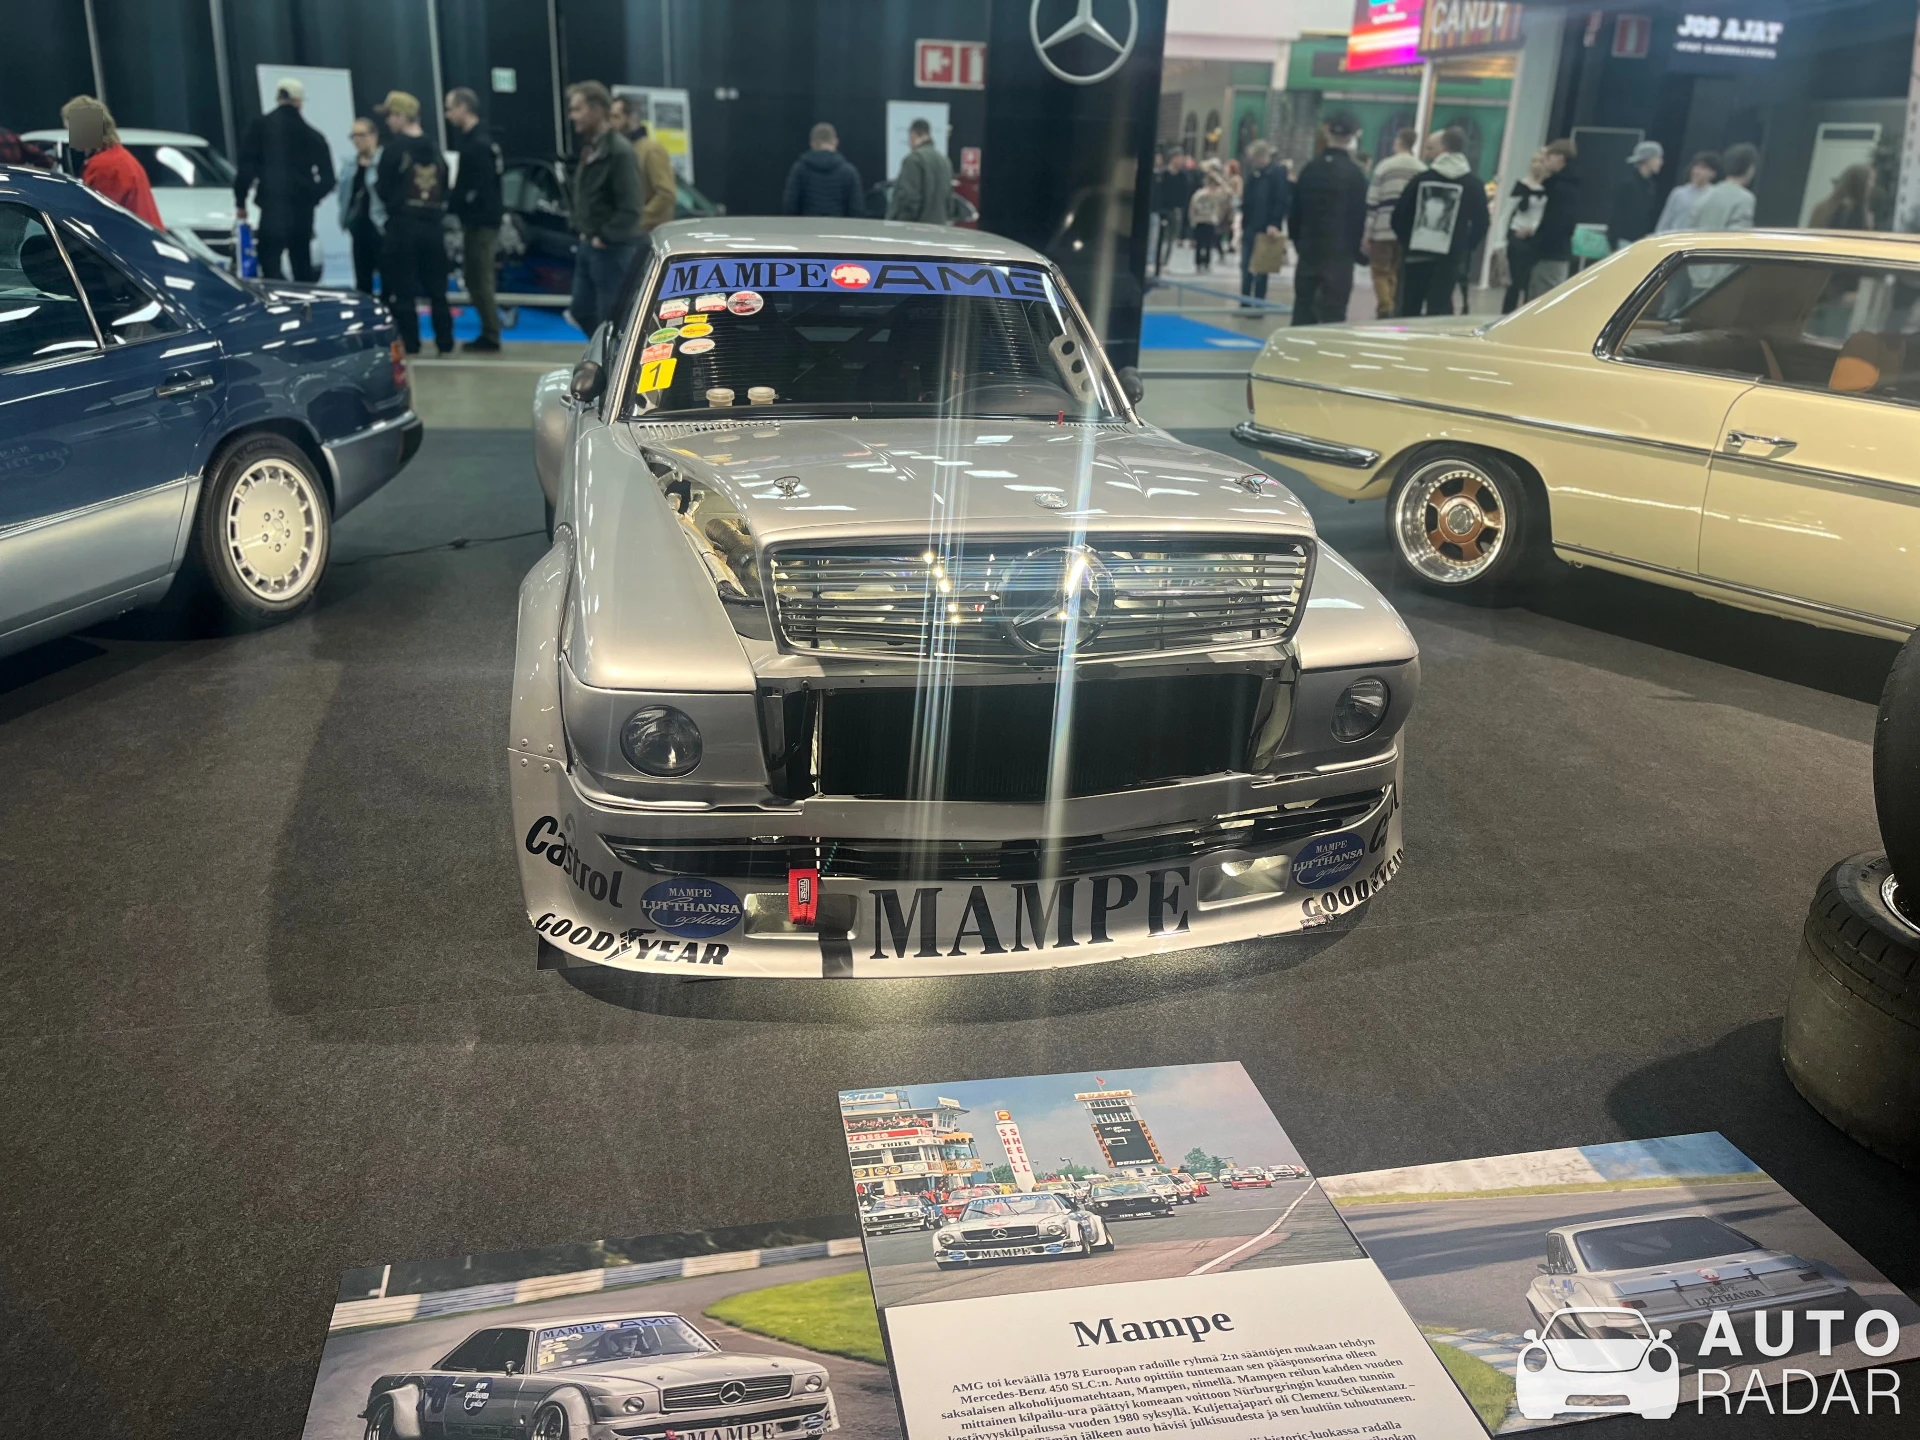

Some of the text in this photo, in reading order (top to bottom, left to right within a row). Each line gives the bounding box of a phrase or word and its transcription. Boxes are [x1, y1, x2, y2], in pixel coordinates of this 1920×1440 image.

[1677, 13, 1720, 38] JOS
[672, 263, 1046, 299] MAMPE AMG
[650, 363, 662, 388] 1
[525, 815, 623, 908] Castrol
[1293, 848, 1364, 872] LUFTHANSA
[1315, 840, 1348, 854] MAMPE
[641, 899, 741, 914] LUFTHANSA
[669, 888, 712, 898] MAMPE
[868, 866, 1192, 961] MAMPE
[1000, 1129, 1019, 1173] SHELL
[1010, 1128, 1030, 1172] SHELL
[980, 1246, 1031, 1258] MAMPE
[1694, 1289, 1767, 1306] LUFTHANSA
[543, 1324, 605, 1339] MAMPE
[1069, 1312, 1235, 1347] Mampe
[952, 1338, 1376, 1393] AMG toi keväällä 1978 Euroopan radoille ryhmä 2:n sääntöjen mukaan tehdyn
[960, 1350, 1377, 1405] Mercedes-Benz 450 SLC:n. Auto opittiin tuntemaan sen pääsponsorina olleen
[941, 1358, 1403, 1420] saksalaisen alkoholijuomatehtaan, Mampen, nimellä. Mampen reilun kahden vuoden
[961, 1371, 1395, 1430] mittainen kilpailu-ura päättyi komeaan voittoon Nürburgringin kuuden tunnin
[1068, 1417, 1111, 1429] vuoden
[1113, 1412, 1140, 1424] 1980
[1142, 1406, 1191, 1421] syksyllä.
[1192, 1396, 1273, 1414] Kuljettajapari
[1275, 1394, 1289, 1404] oli
[1291, 1391, 1340, 1402] Clemenz
[1340, 1383, 1407, 1397] Schikentanz
[1081, 1426, 1123, 1440] jälkeen
[1126, 1426, 1151, 1436] auto
[1153, 1420, 1187, 1432] hävisi
[1190, 1413, 1265, 1430] julkisuudesta
[1267, 1409, 1279, 1420] ja
[1280, 1408, 1300, 1417] sen
[1301, 1402, 1343, 1414] luultiin
[1344, 1394, 1416, 1409] tuhoutuneen.
[1362, 1420, 1402, 1433] radalla
